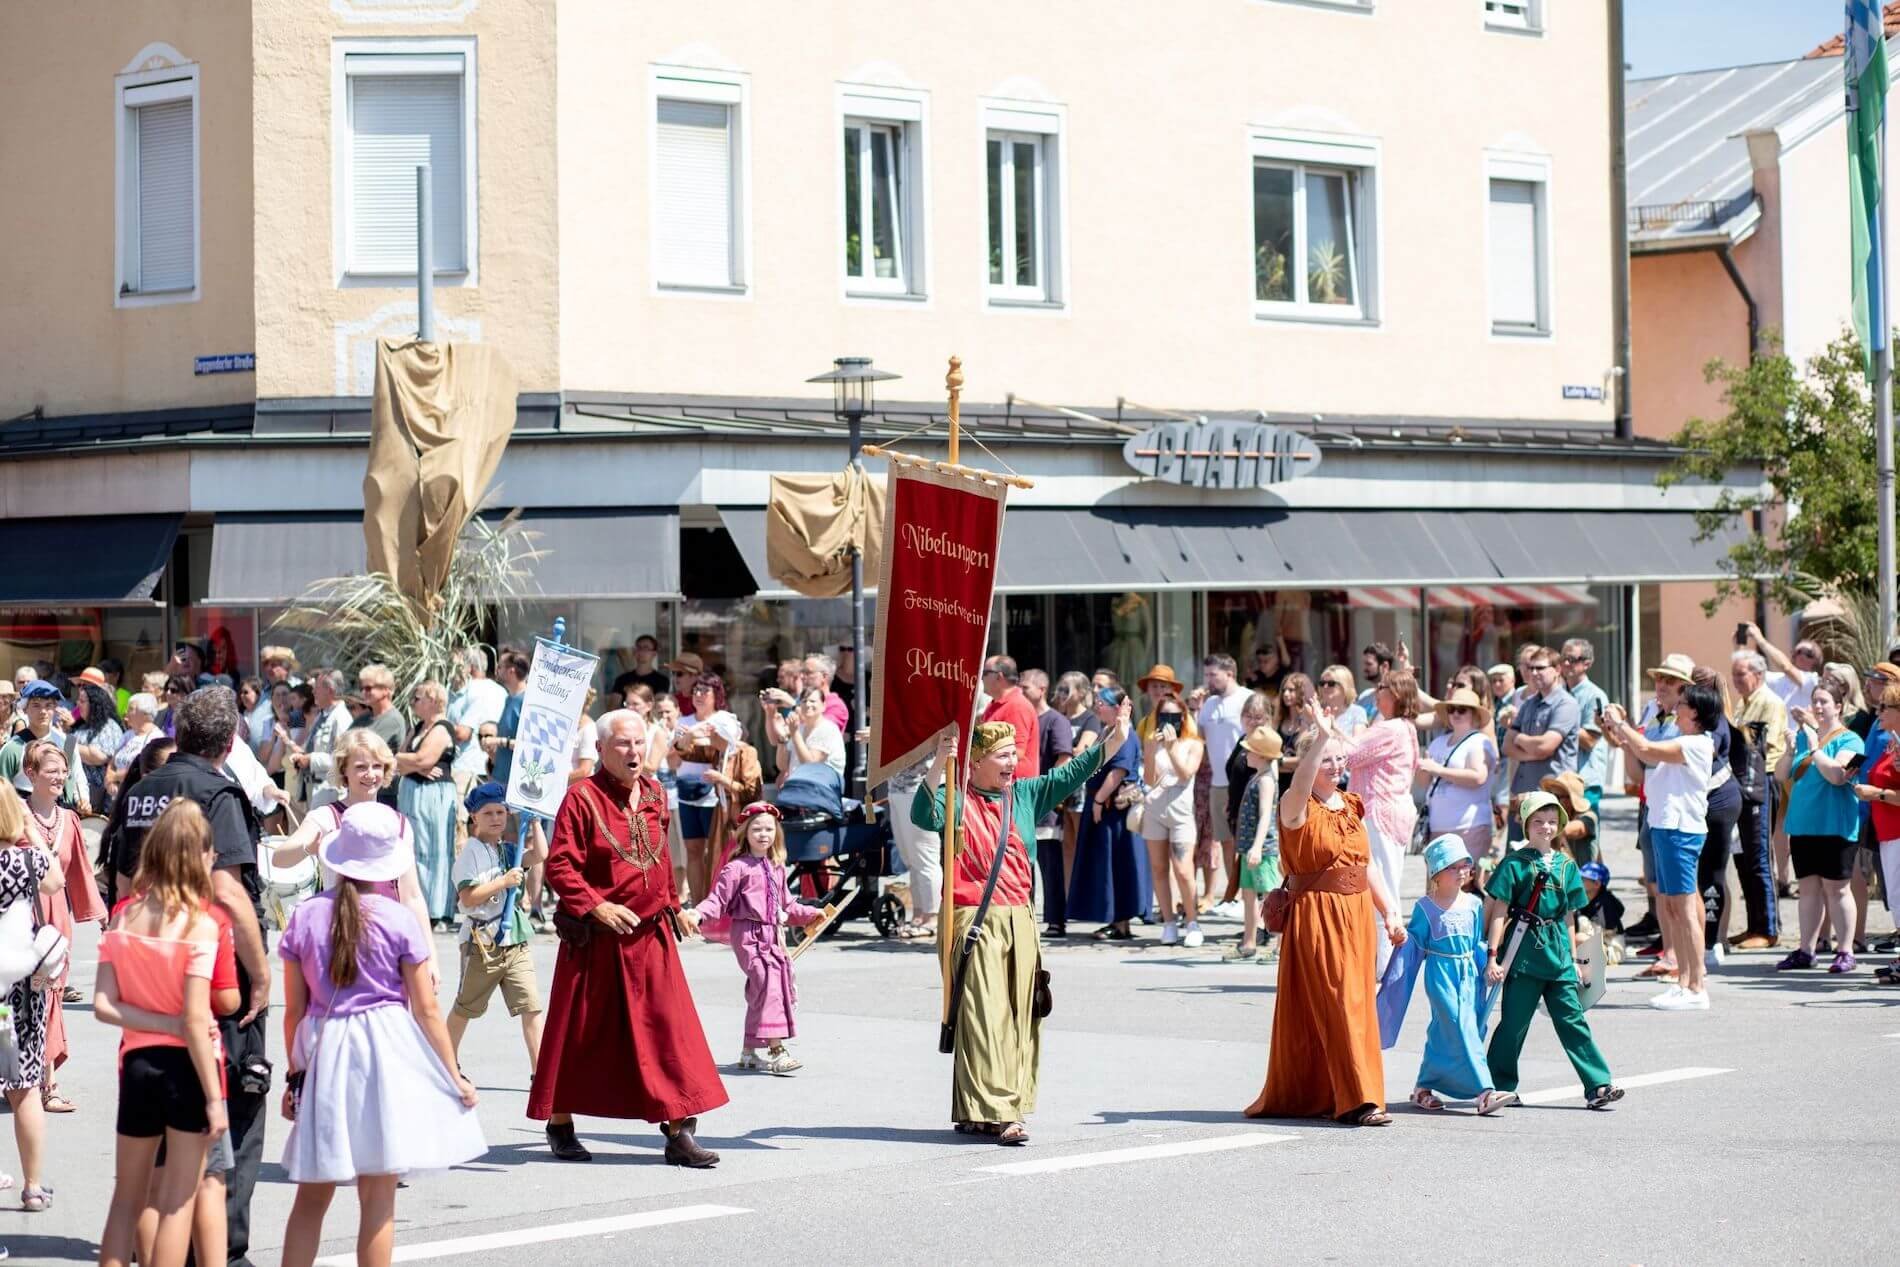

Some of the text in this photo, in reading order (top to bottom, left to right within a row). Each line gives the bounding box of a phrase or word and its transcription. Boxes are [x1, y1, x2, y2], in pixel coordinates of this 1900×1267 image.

[1156, 425, 1297, 489] PLATIN
[901, 522, 989, 574] Nibelungen
[906, 647, 978, 702] Plattlng
